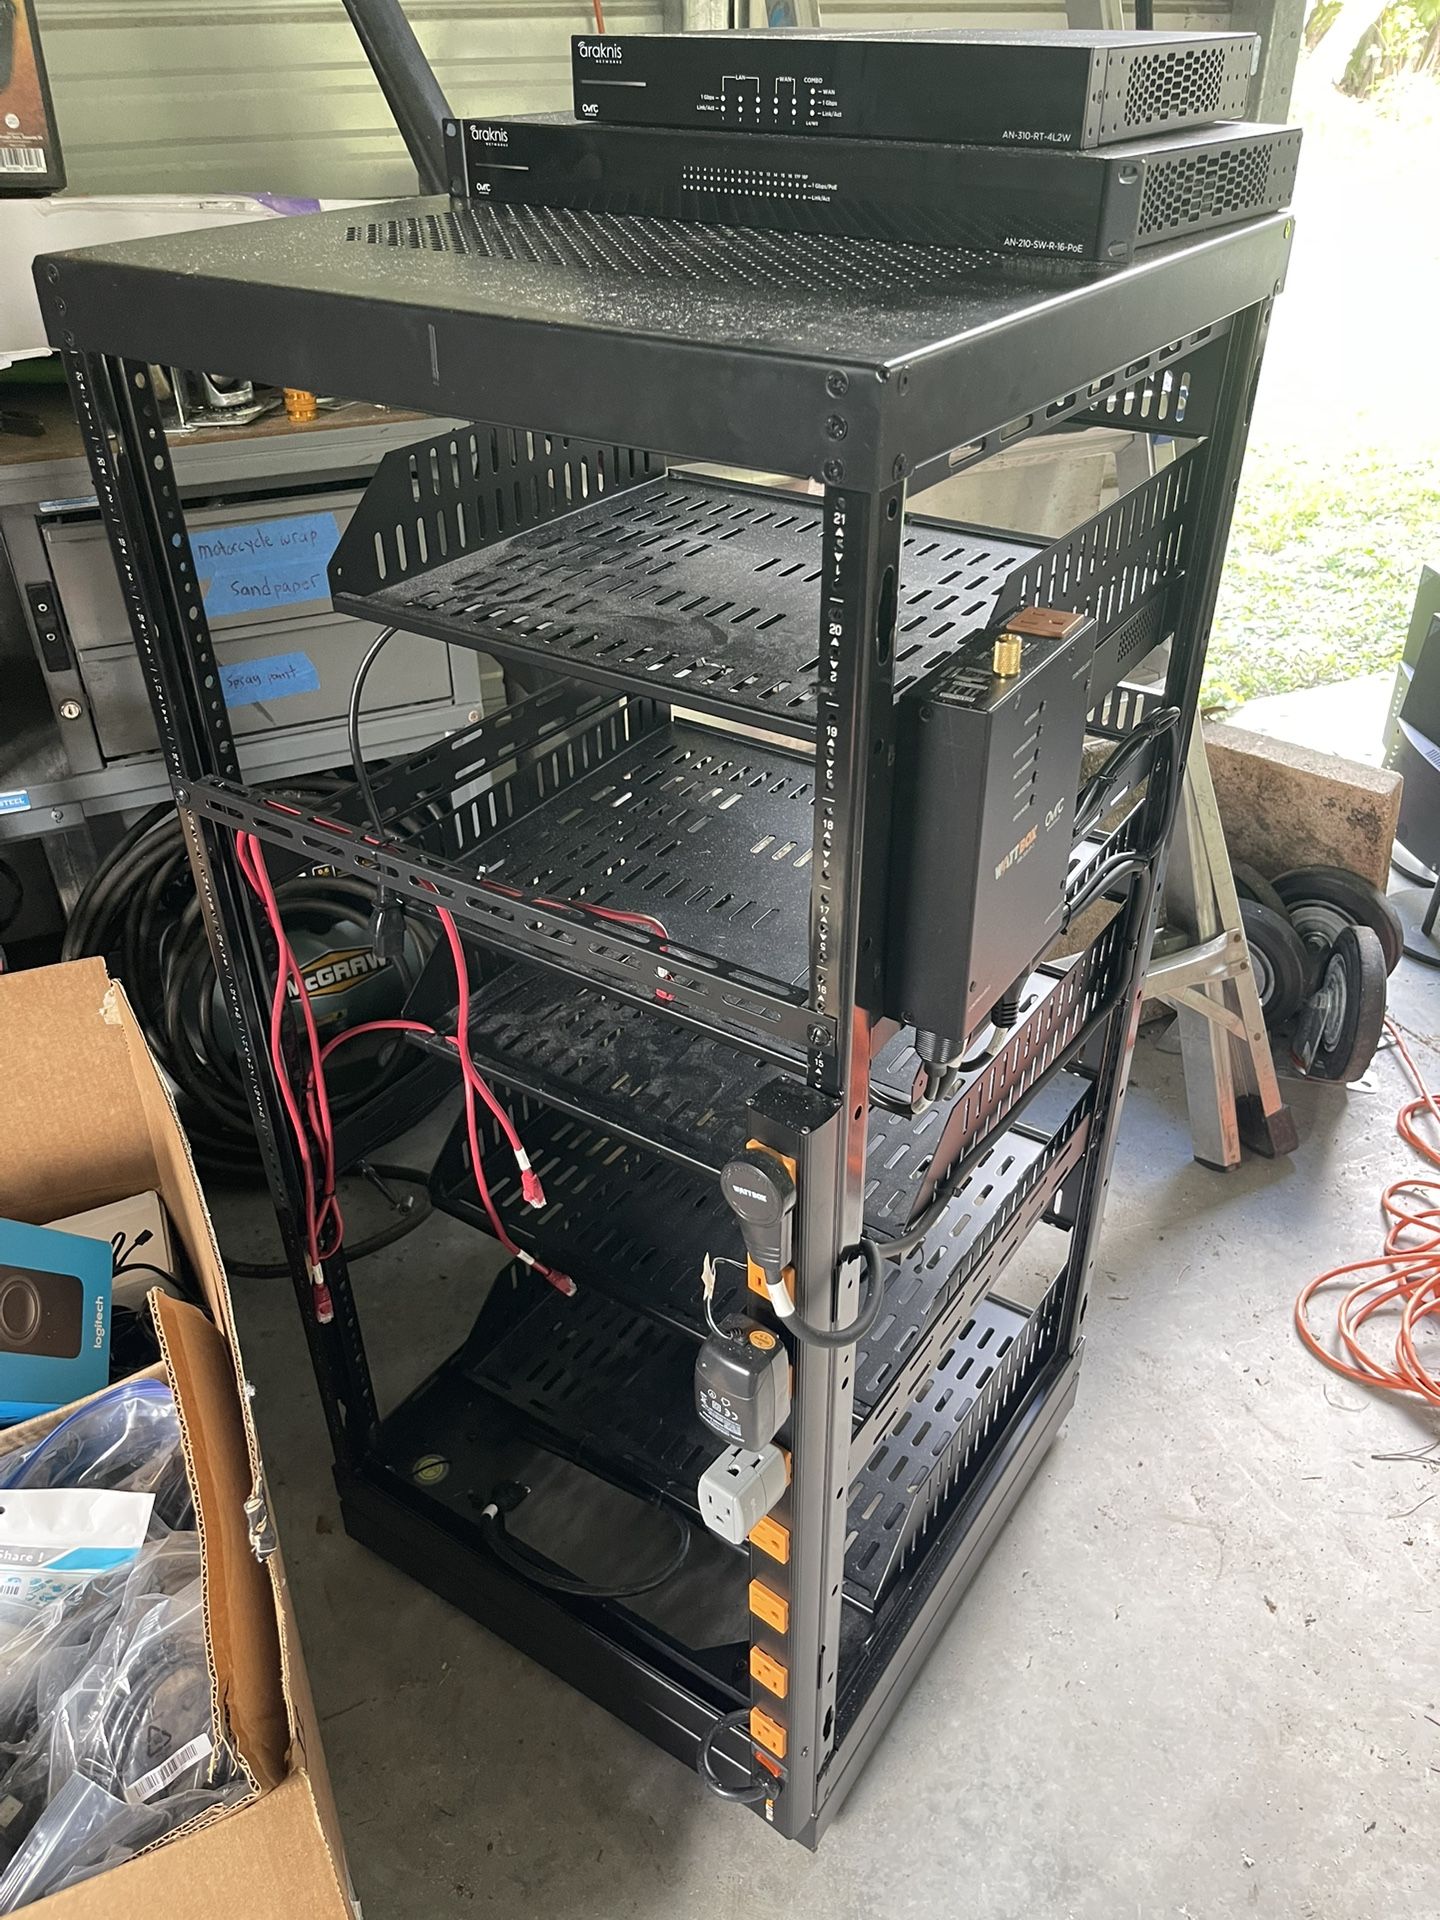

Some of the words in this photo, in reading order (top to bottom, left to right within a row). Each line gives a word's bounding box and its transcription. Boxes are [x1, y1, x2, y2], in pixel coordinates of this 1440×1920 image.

[578, 41, 622, 58] araknis
[470, 125, 508, 143] araknis
[1002, 131, 1071, 142] AN-310-RT-4L2W
[833, 511, 846, 526] 21
[828, 622, 842, 636] 20
[826, 725, 838, 738] 19
[822, 818, 834, 831] 18
[820, 905, 830, 915] 17
[816, 984, 827, 995] 16
[814, 1058, 825, 1068] 15
[93, 1295, 106, 1349] logitech
